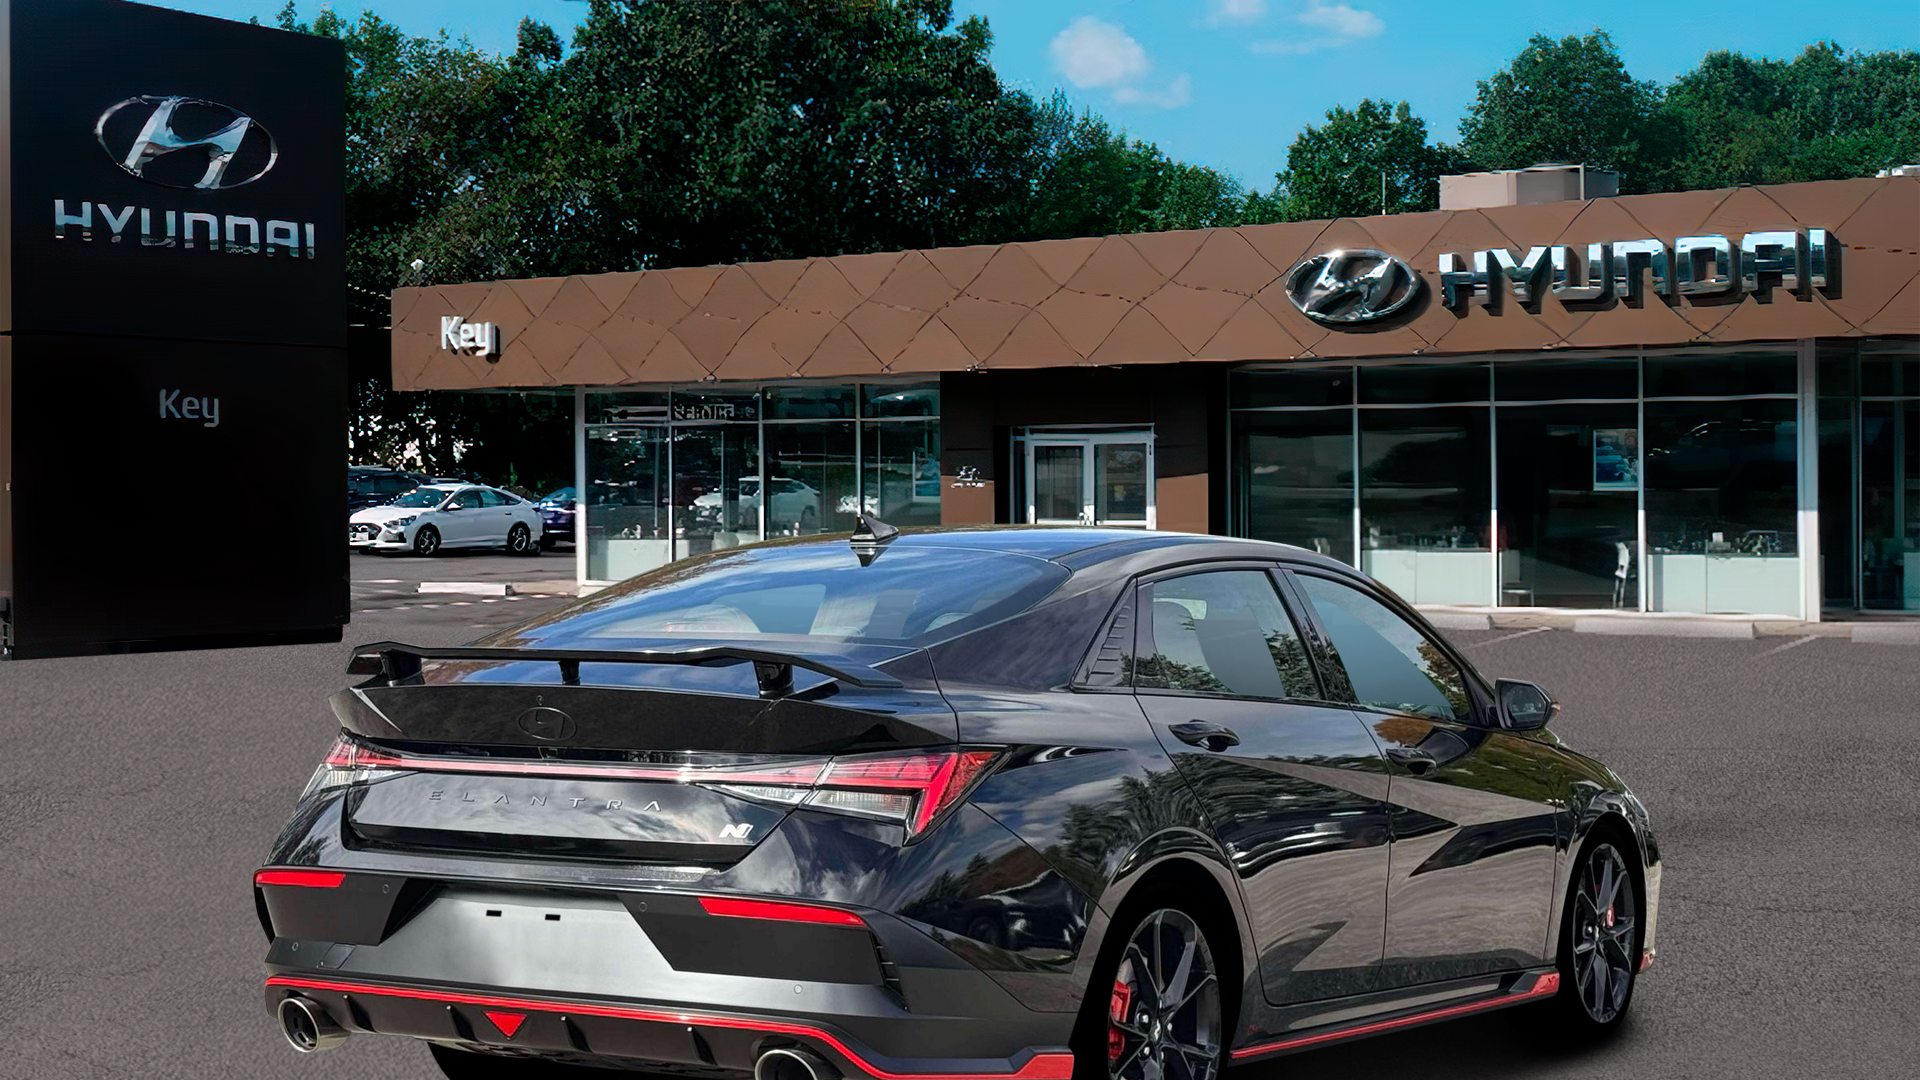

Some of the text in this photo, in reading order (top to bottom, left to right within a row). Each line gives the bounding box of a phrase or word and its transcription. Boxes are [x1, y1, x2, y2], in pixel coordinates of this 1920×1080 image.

[54, 199, 315, 260] HYUNDAI
[1438, 228, 1842, 315] HYUNDAI
[441, 315, 494, 357] Key
[159, 388, 220, 428] Key
[428, 790, 662, 812] ELANTRA
